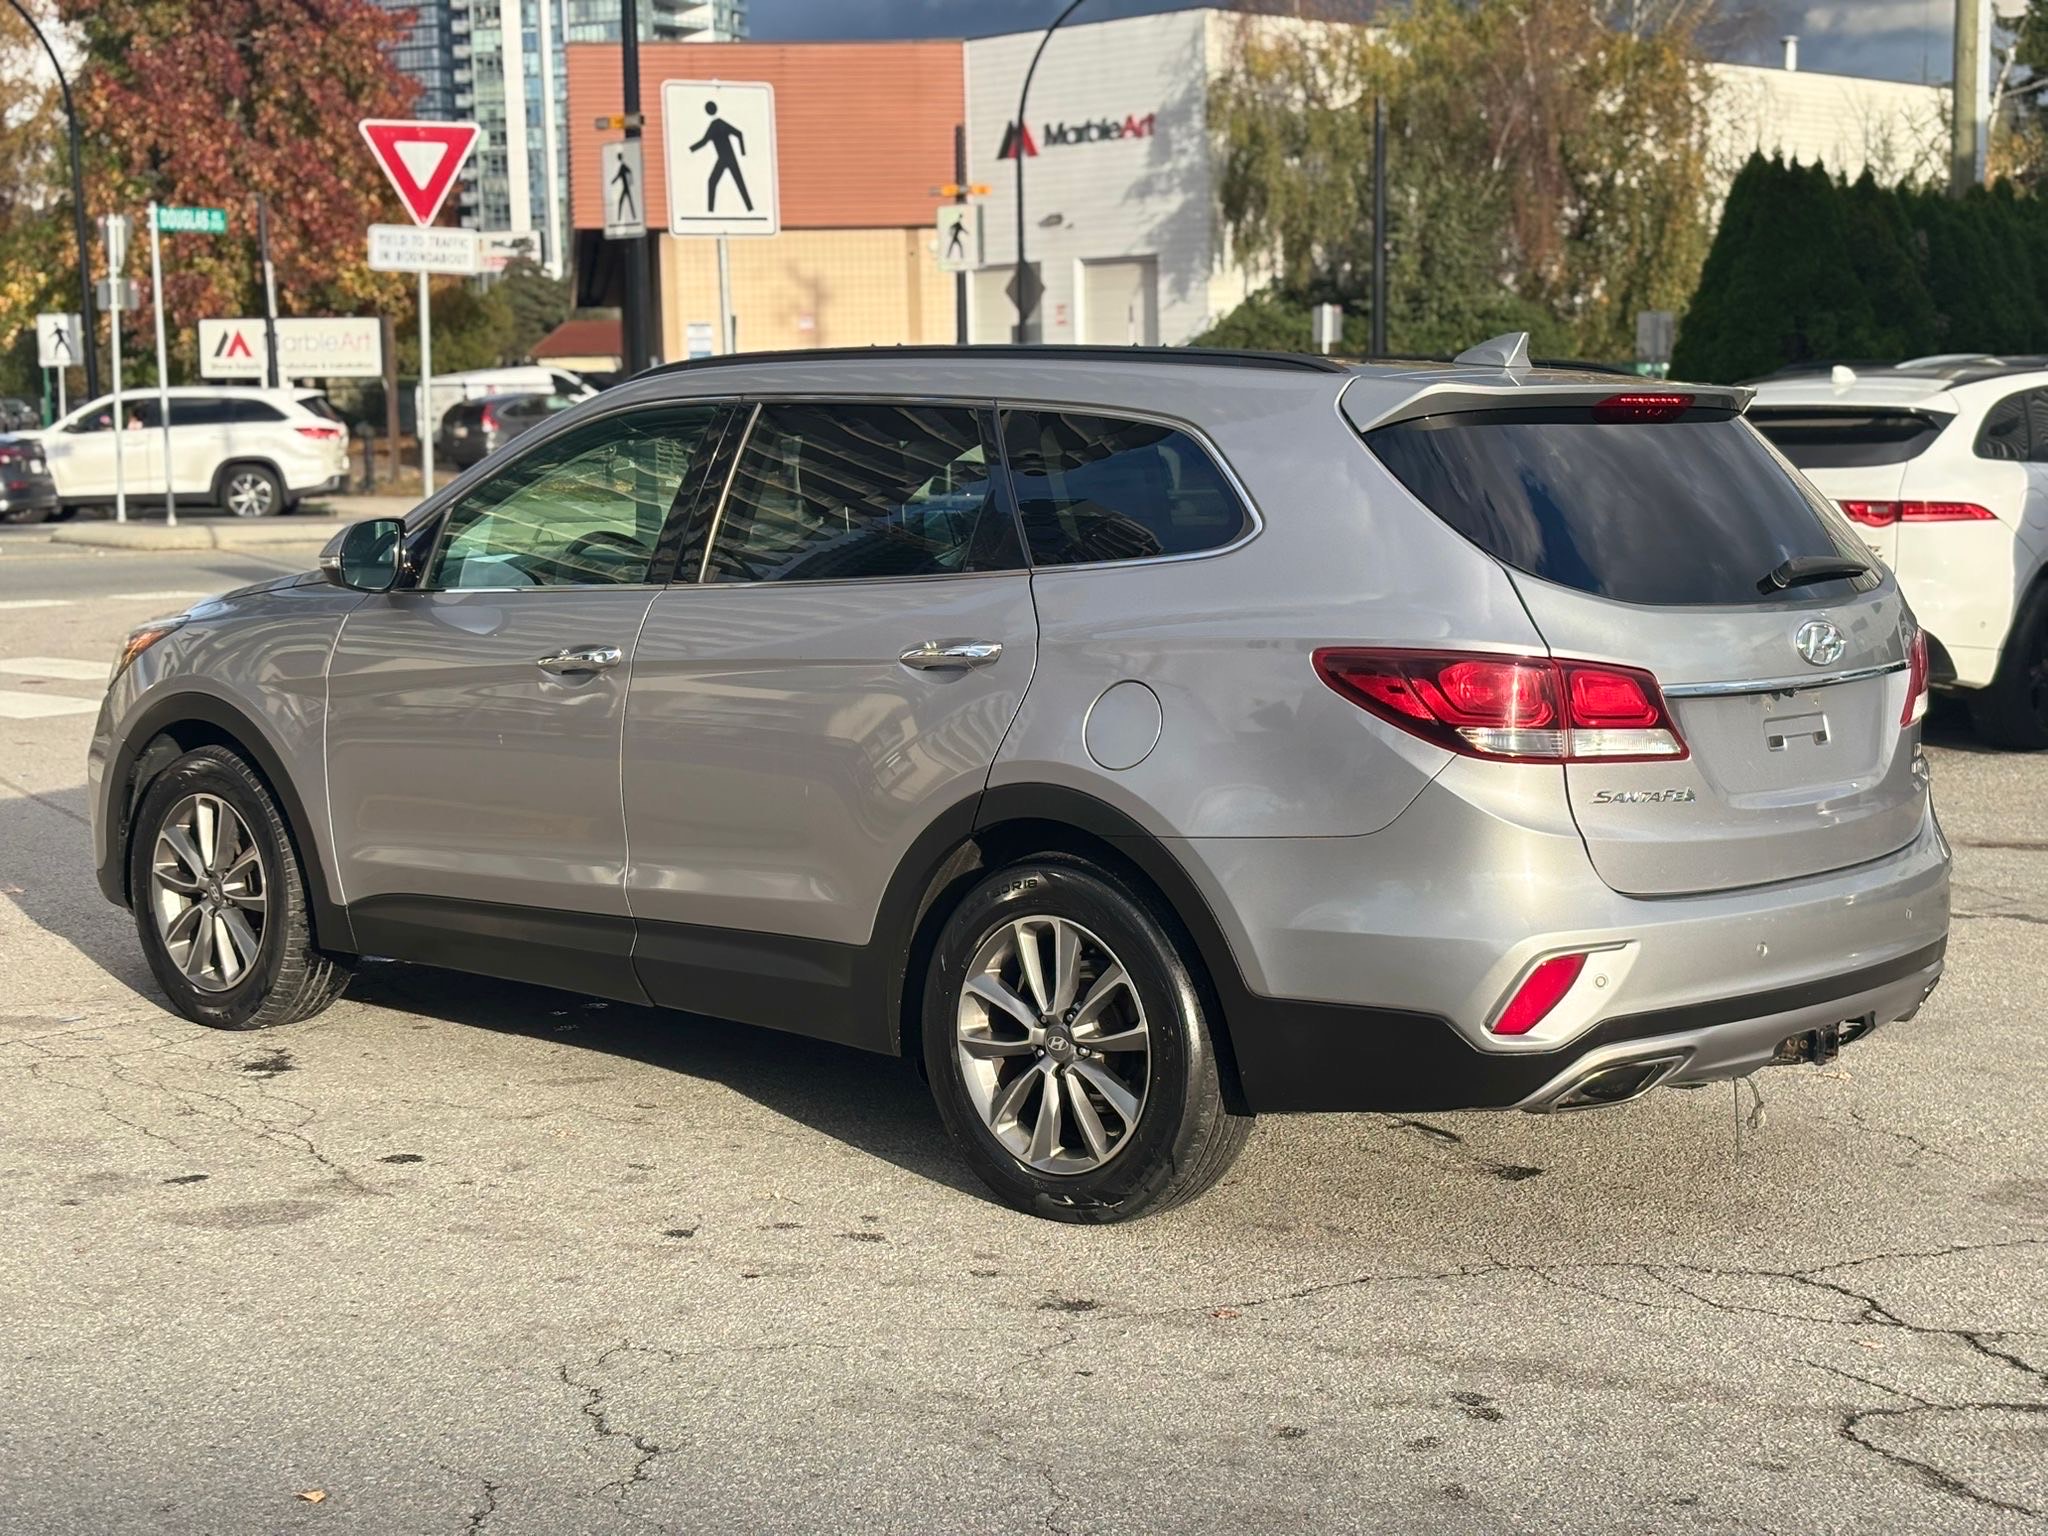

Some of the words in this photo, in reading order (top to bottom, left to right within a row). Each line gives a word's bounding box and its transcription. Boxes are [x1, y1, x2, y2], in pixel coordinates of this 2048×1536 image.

[1044, 113, 1156, 146] MarbleArt
[160, 208, 209, 230] DOUGLAS
[429, 236, 470, 249] TRAFFIC
[265, 331, 371, 352] arbleArt
